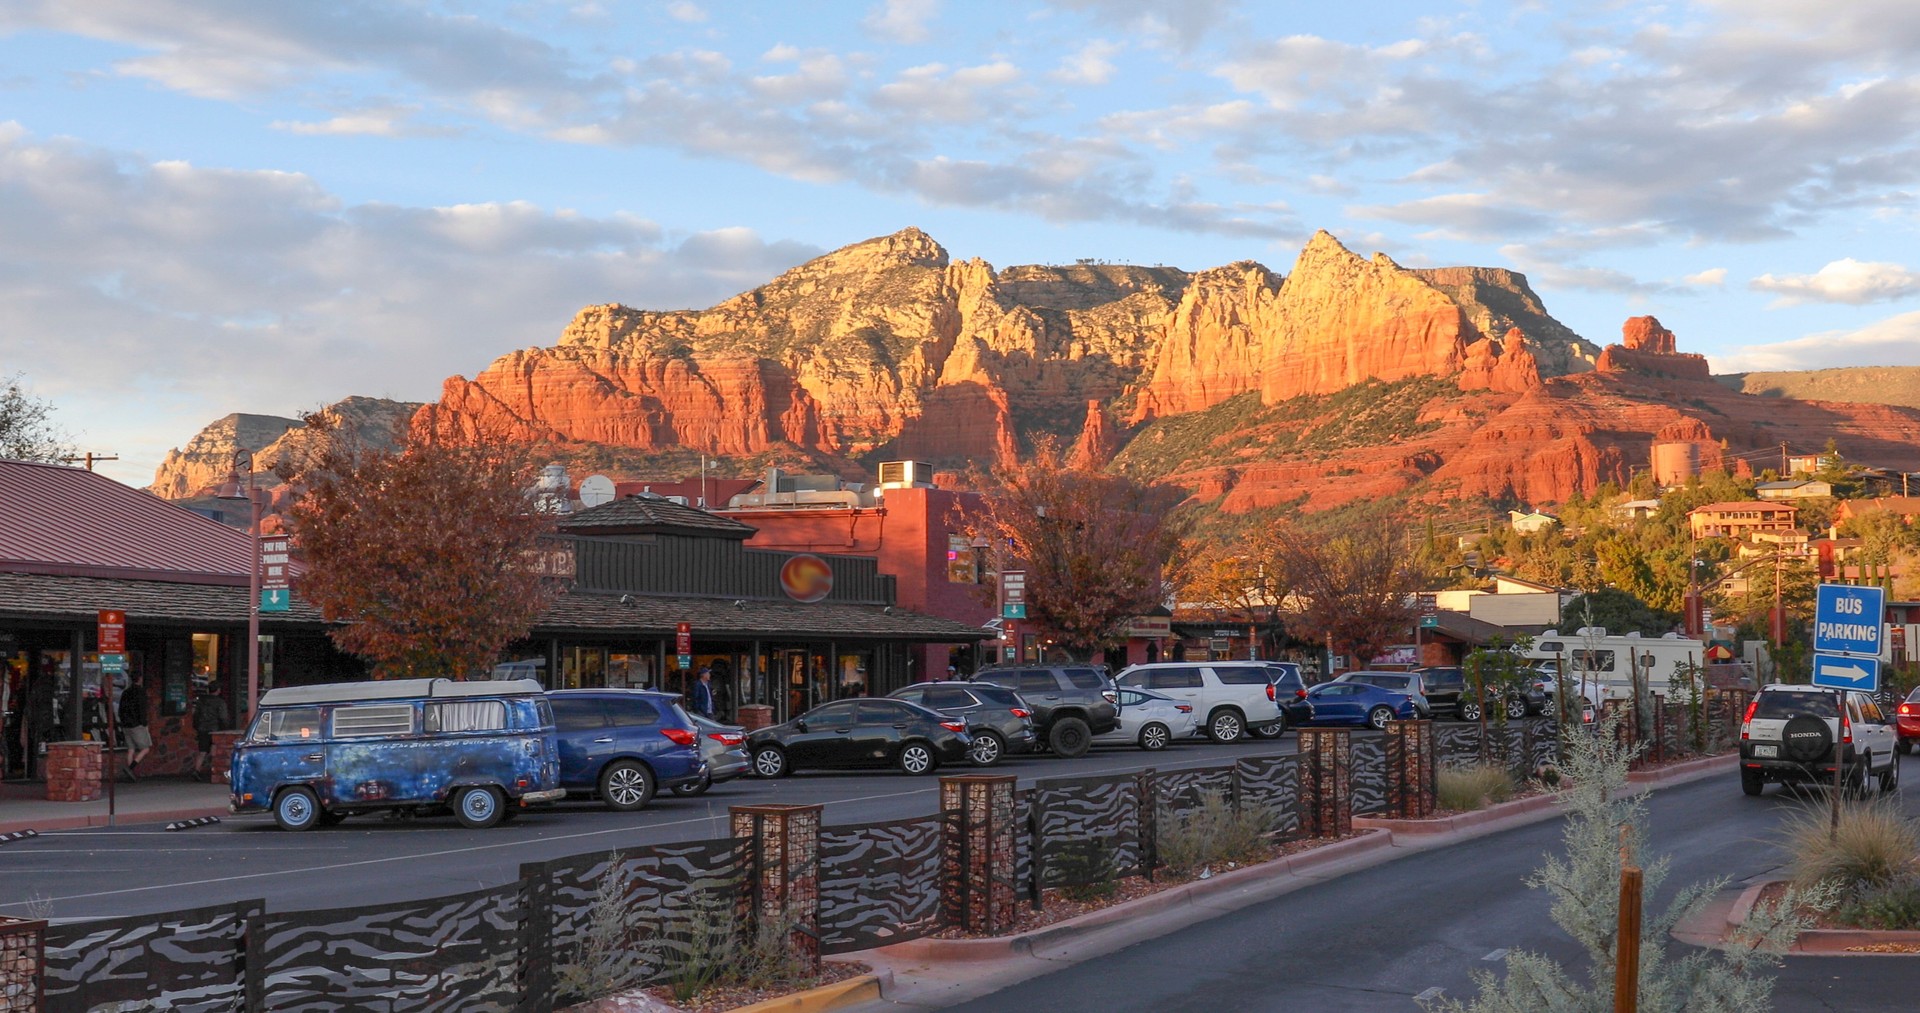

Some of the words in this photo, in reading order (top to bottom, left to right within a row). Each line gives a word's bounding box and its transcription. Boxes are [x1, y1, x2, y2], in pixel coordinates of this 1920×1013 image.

[264, 542, 274, 552] PAY
[264, 554, 288, 564] PARKING
[1835, 597, 1862, 615] BUS
[1818, 622, 1877, 642] PARKING
